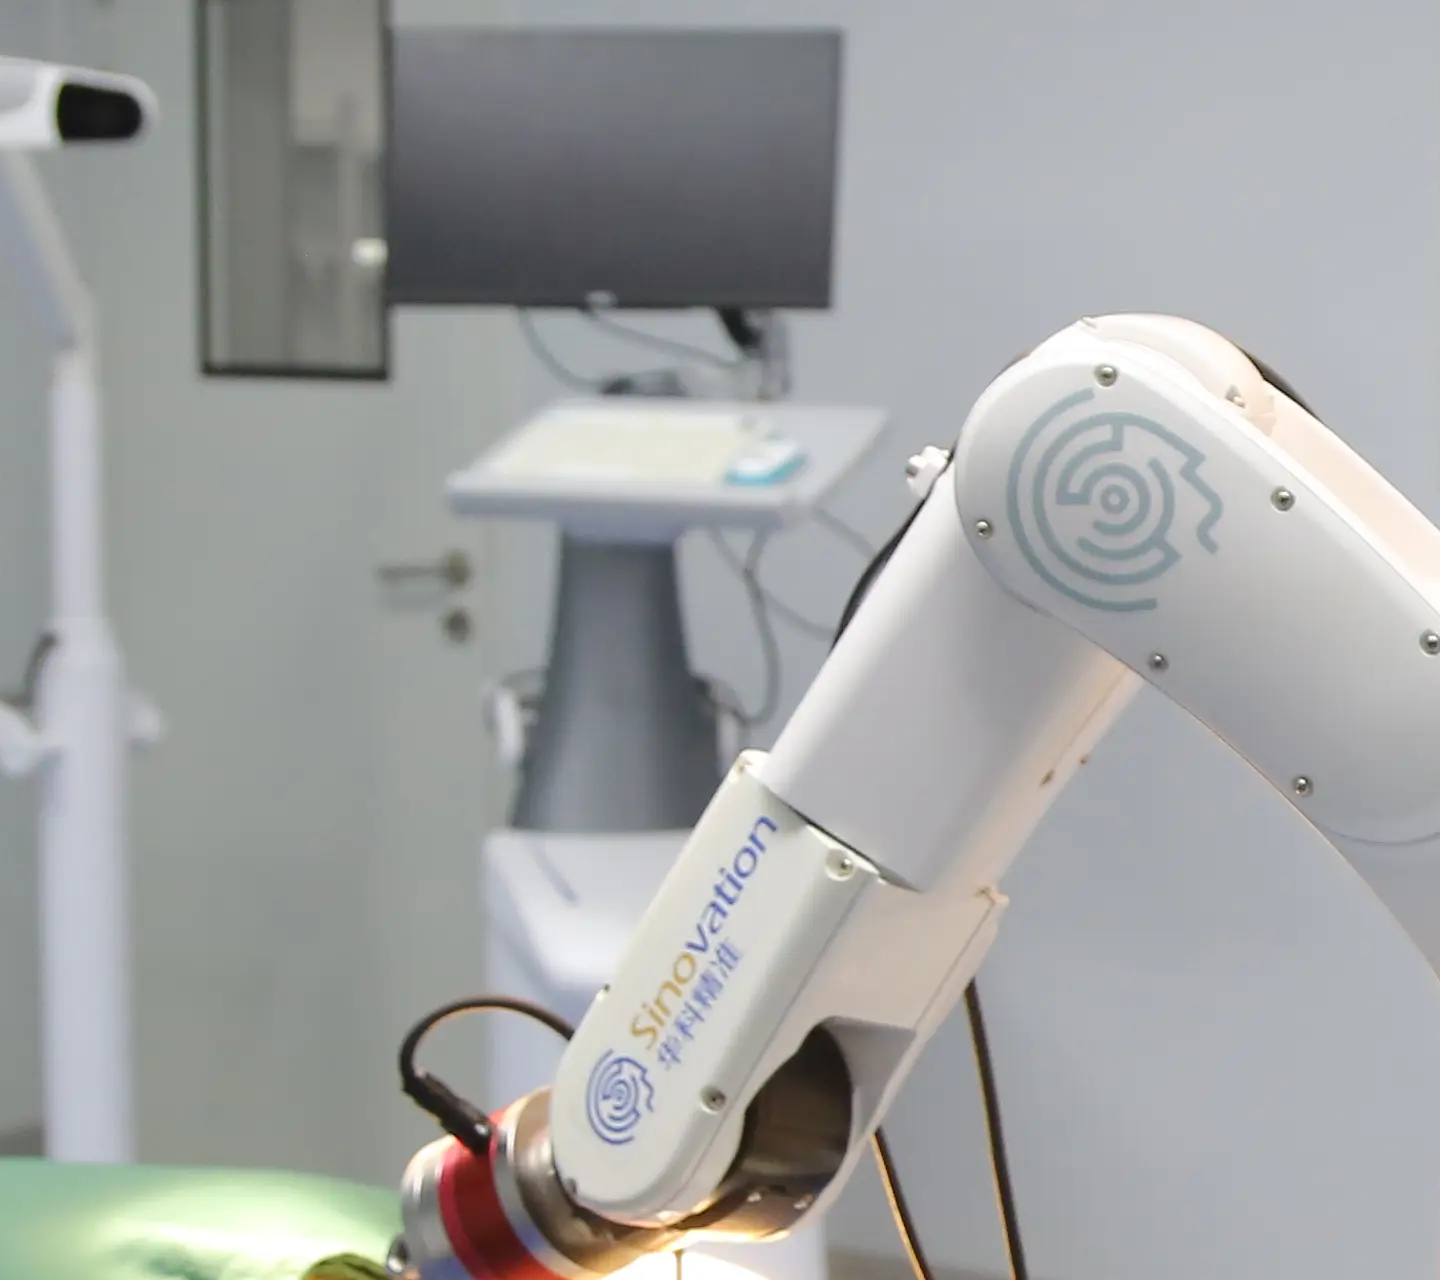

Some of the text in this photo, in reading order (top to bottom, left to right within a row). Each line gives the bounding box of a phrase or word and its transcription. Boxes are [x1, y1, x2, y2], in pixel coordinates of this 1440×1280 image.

[629, 814, 779, 1051] Sinovation
[658, 937, 743, 1072] 华科精准
